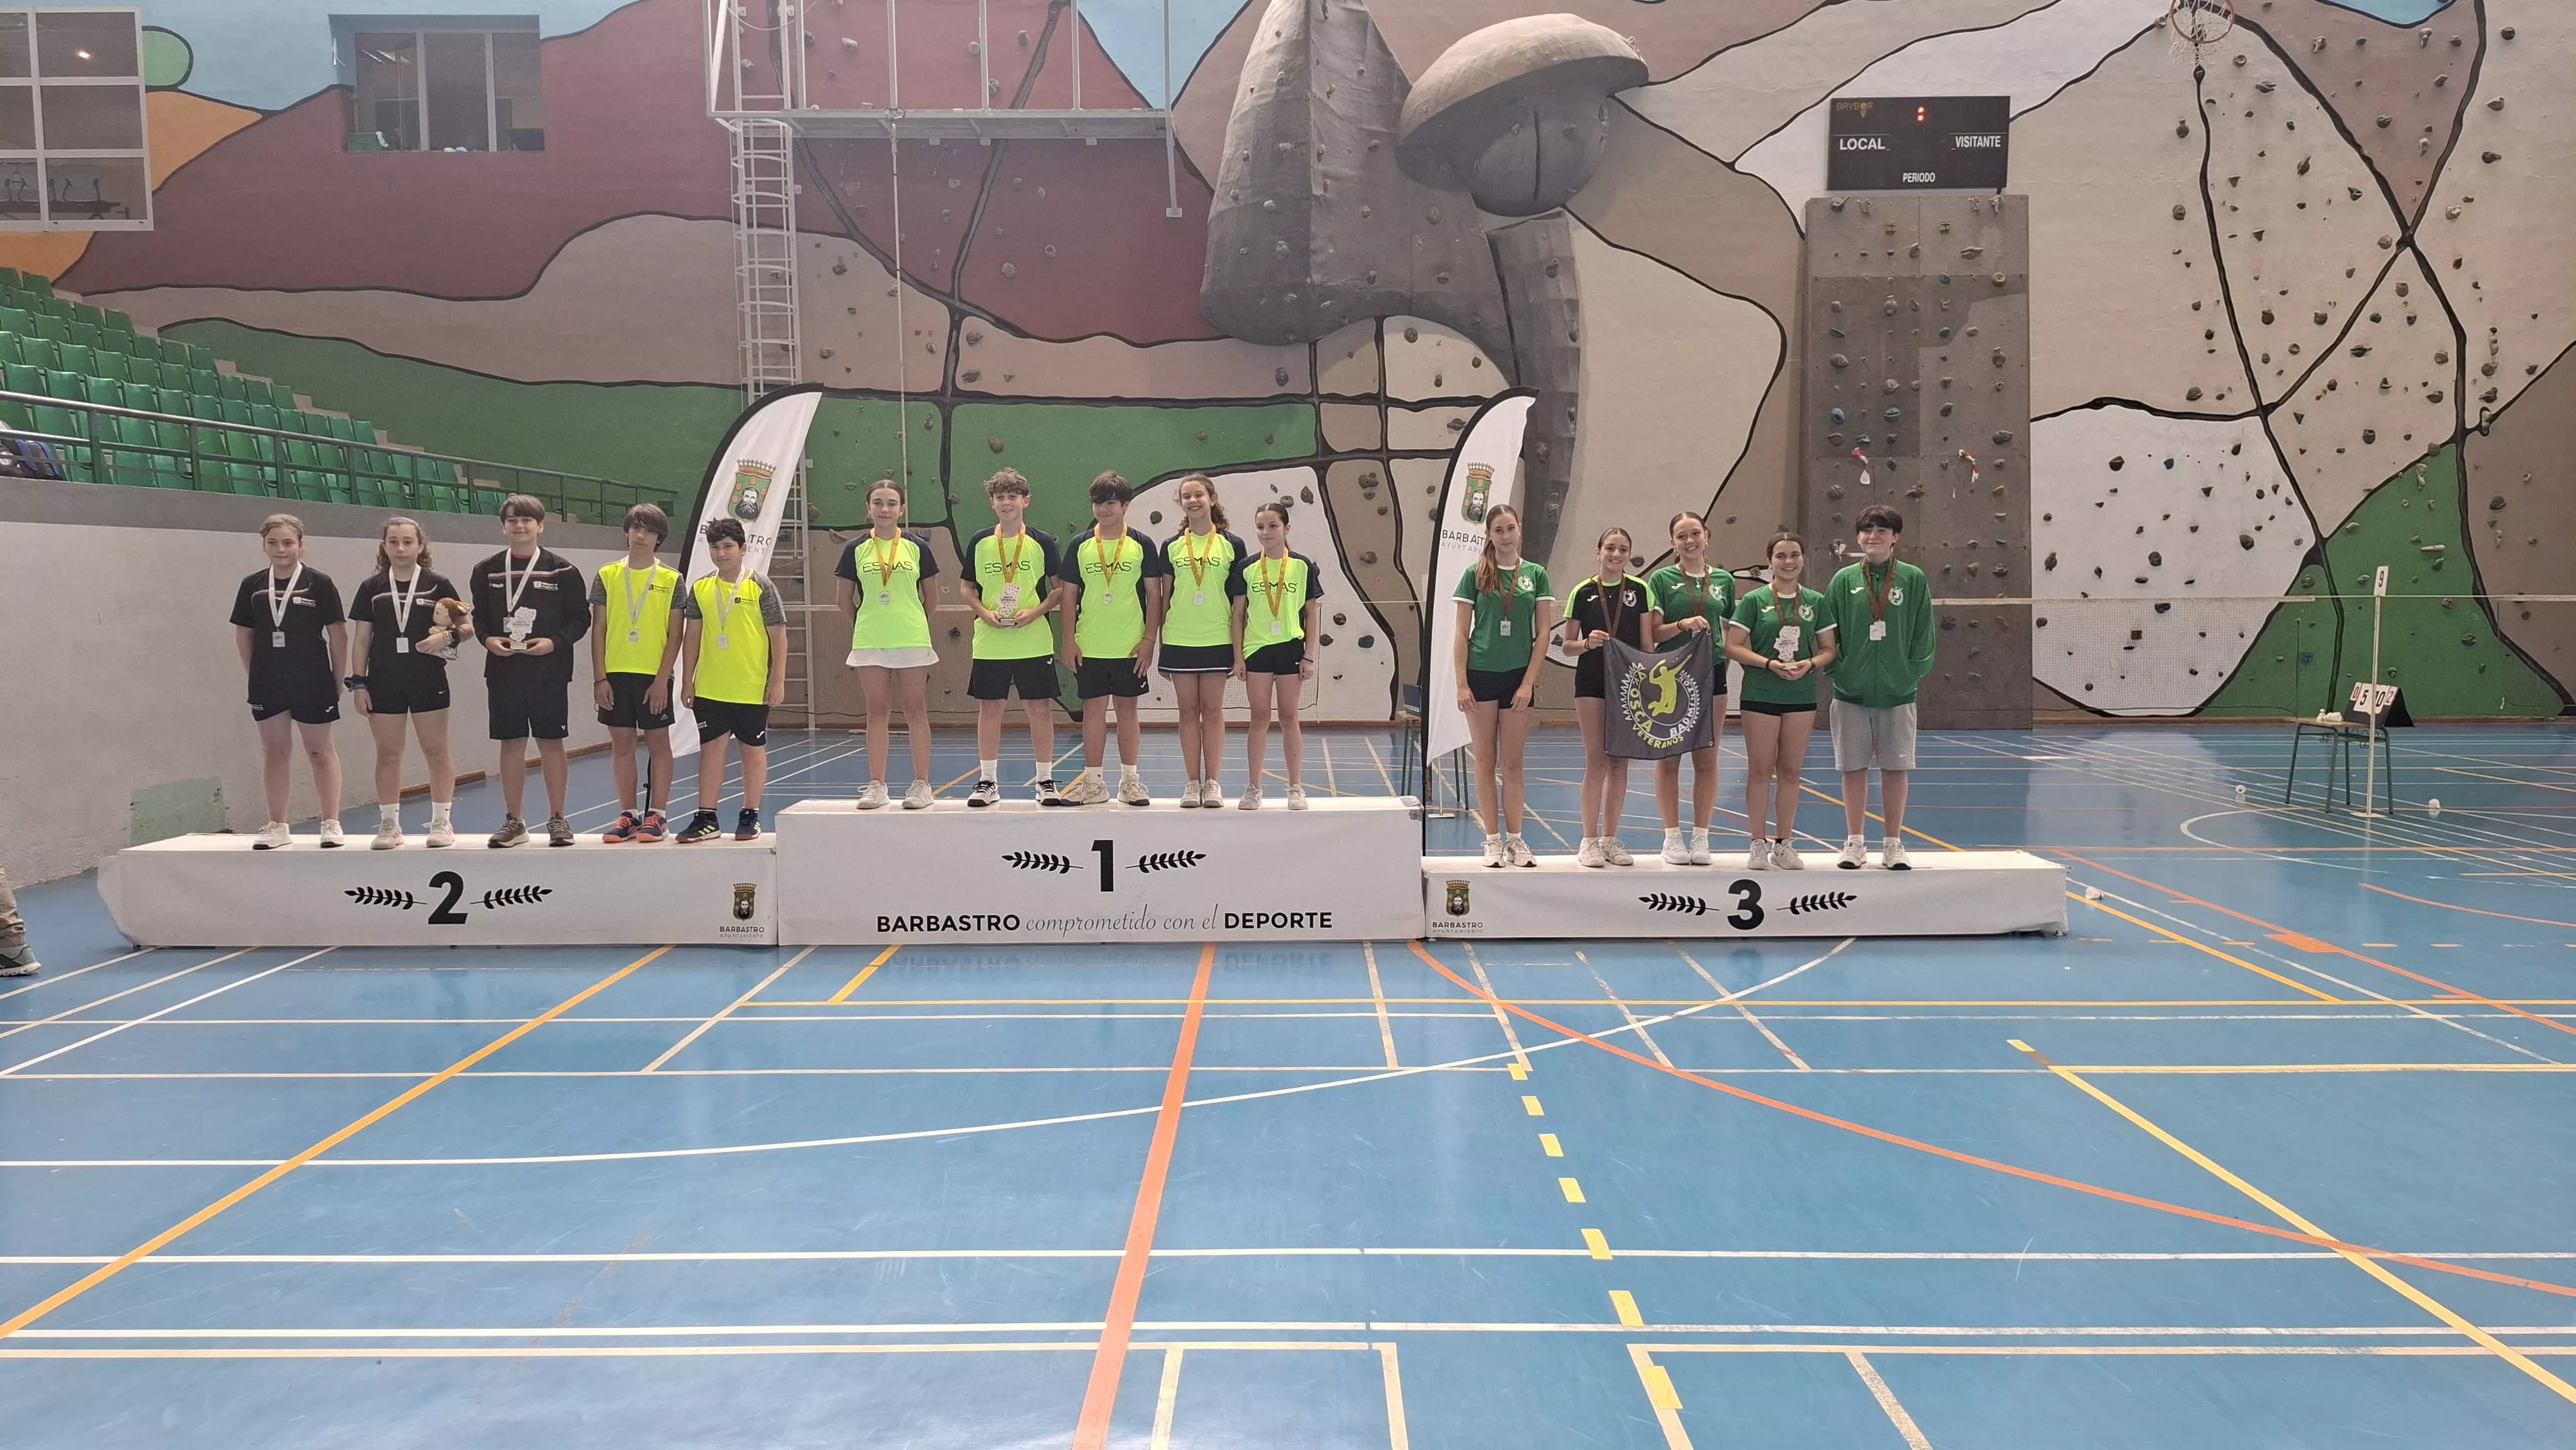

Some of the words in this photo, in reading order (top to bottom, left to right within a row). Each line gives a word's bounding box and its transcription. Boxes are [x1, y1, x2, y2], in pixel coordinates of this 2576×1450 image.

[1839, 138, 1886, 150] LOCAL
[1955, 135, 2001, 148] VISITANTE
[1902, 172, 1936, 183] PERIODO
[1442, 529, 1485, 546] BARBAST
[2378, 570, 2385, 587] 9
[2352, 686, 2359, 699] 0
[2359, 690, 2369, 706] 5
[2386, 690, 2394, 704] 2
[1630, 688, 1654, 733] OSCA
[1669, 675, 1696, 738] BADMINTON
[1632, 723, 1684, 748] VETERANOS
[1092, 840, 1114, 892] 1
[427, 871, 469, 925] 2
[1727, 879, 1765, 930] 3
[877, 914, 1020, 933] BARBASTRO
[1026, 904, 1156, 938] comprometido
[1163, 918, 1195, 930] con
[1202, 903, 1219, 930] el
[1225, 911, 1332, 929] DEPORTE
